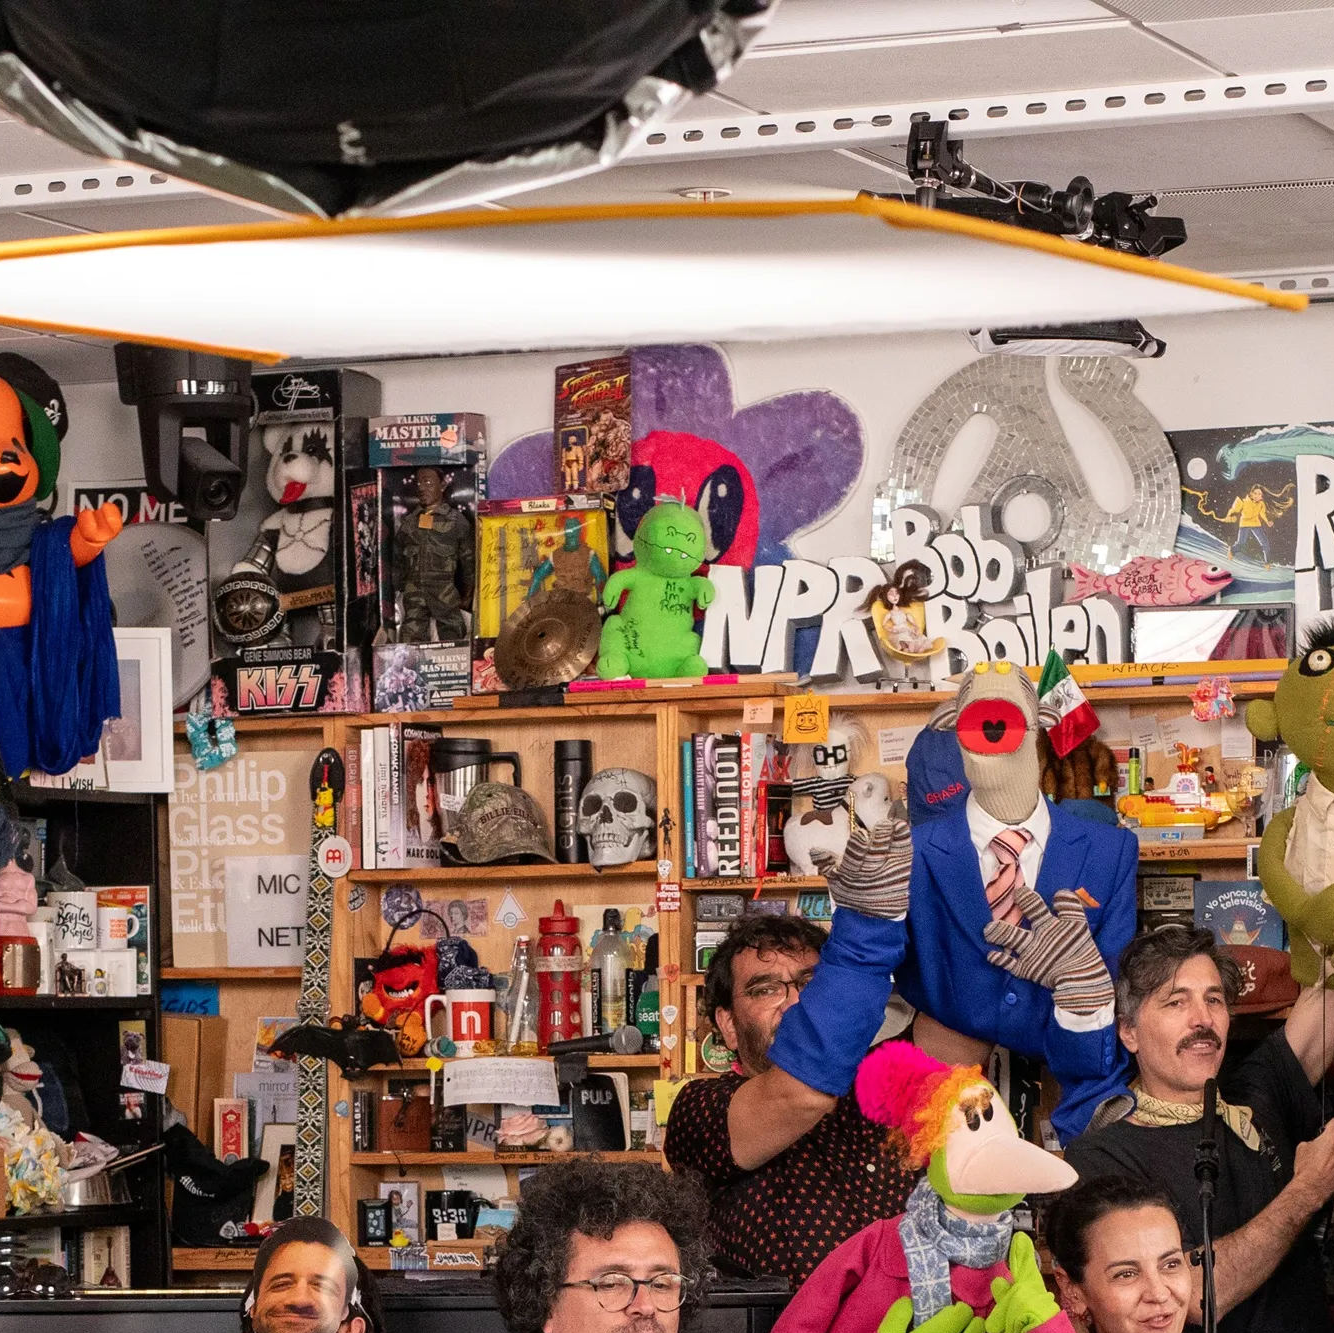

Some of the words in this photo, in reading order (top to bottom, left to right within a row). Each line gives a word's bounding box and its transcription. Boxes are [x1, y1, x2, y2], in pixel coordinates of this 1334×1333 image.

[397, 415, 437, 425] TALKING
[375, 426, 441, 441] MASTER
[892, 504, 1017, 604] Bob
[702, 559, 889, 684] NPR
[927, 566, 1129, 676] Boilen
[244, 650, 263, 663] GENE
[264, 648, 292, 662] SIMMONS
[294, 647, 312, 660] BEAR
[431, 655, 467, 663] TALKING
[420, 664, 455, 673] MASTER
[460, 663, 468, 672] P
[1112, 663, 1176, 673] WHACK
[237, 664, 322, 710] KISS
[741, 742, 752, 765] ASK
[715, 745, 739, 800] LOU
[741, 766, 752, 797] BOB
[69, 777, 94, 790] WISH
[479, 807, 508, 825] BILLIE
[168, 806, 286, 846] Glass
[717, 803, 740, 877] REED
[406, 847, 424, 859] MARC
[257, 874, 301, 895] MIC
[1220, 890, 1246, 902] nunca
[1249, 891, 1259, 899] vi
[1220, 896, 1266, 915] televisión
[257, 927, 305, 947] NET
[460, 1010, 481, 1034] n
[258, 1081, 291, 1092] mirror
[581, 1089, 614, 1106] PULP
[431, 1208, 468, 1224] 9:30
